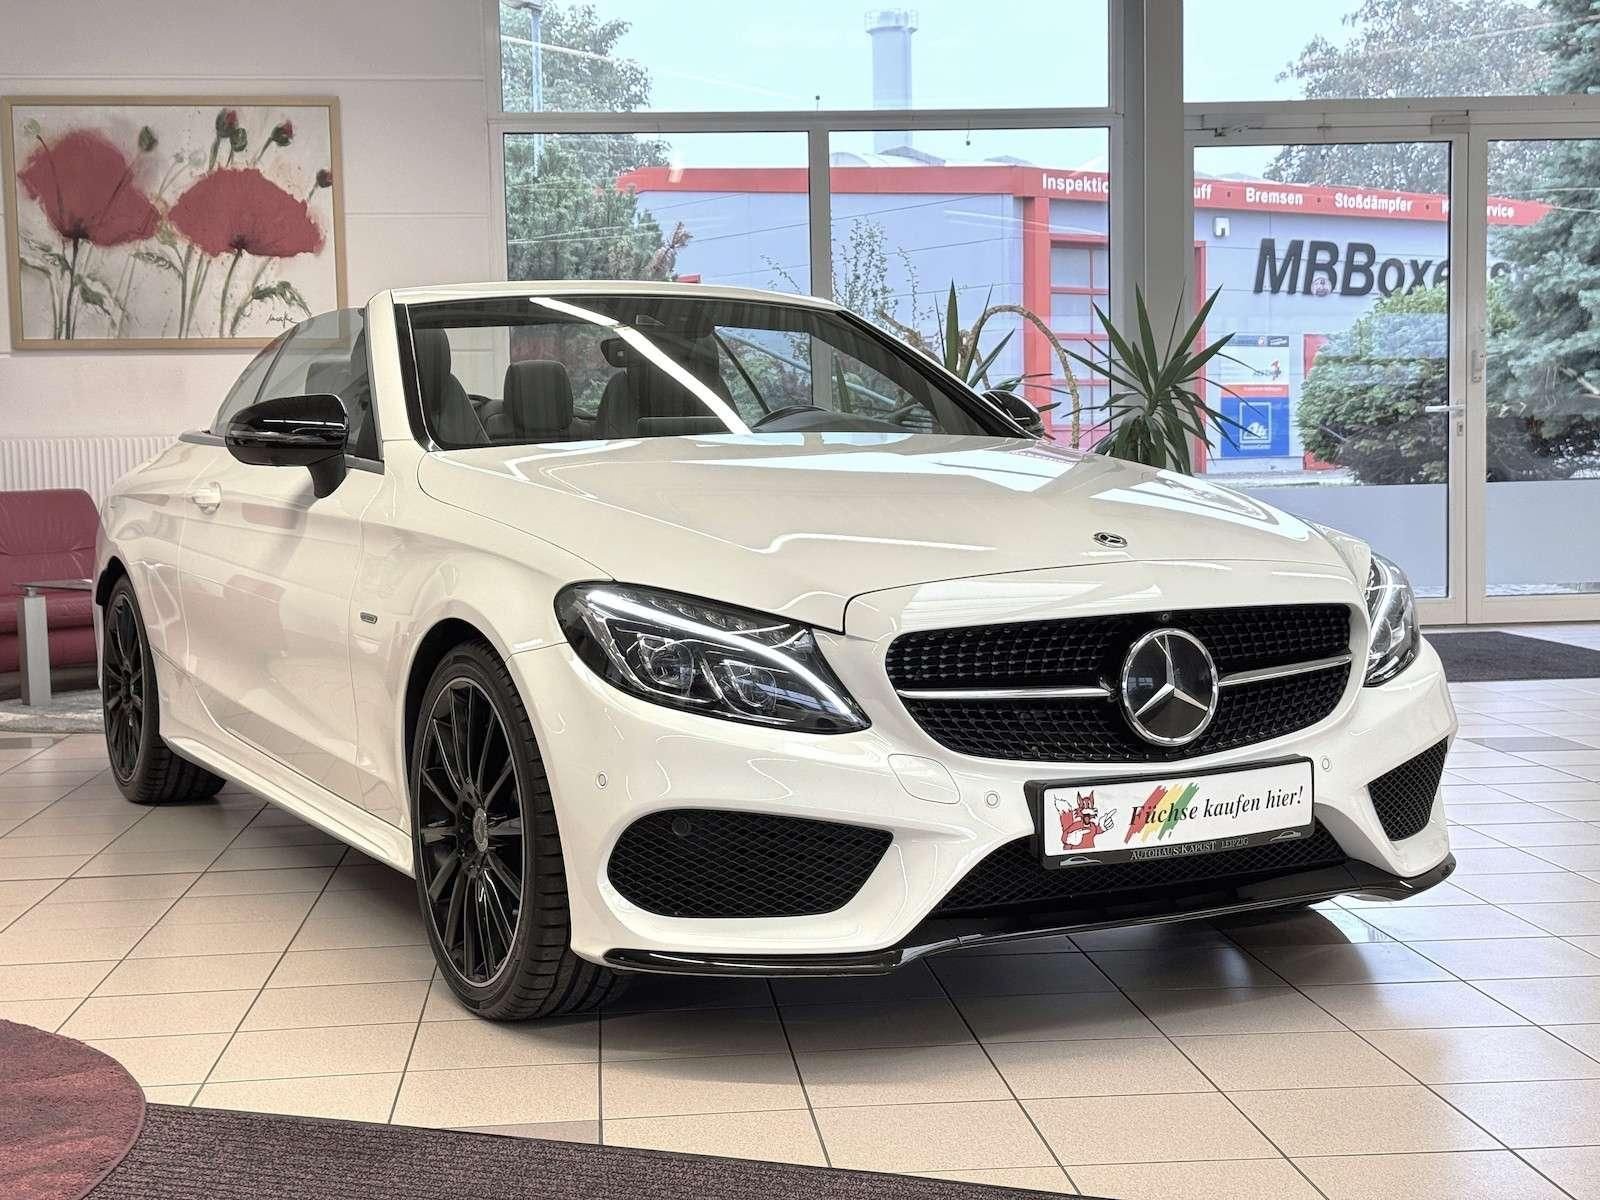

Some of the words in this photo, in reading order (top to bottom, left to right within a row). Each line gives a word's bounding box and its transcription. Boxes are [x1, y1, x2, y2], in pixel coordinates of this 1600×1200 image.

[1042, 173, 1109, 195] Inspektio
[1245, 187, 1304, 206] Bremsen
[1334, 192, 1414, 213] Stoßdämpfer
[1129, 803, 1198, 826] Füchse
[1203, 793, 1260, 819] kaufen
[1266, 785, 1304, 810] hier!
